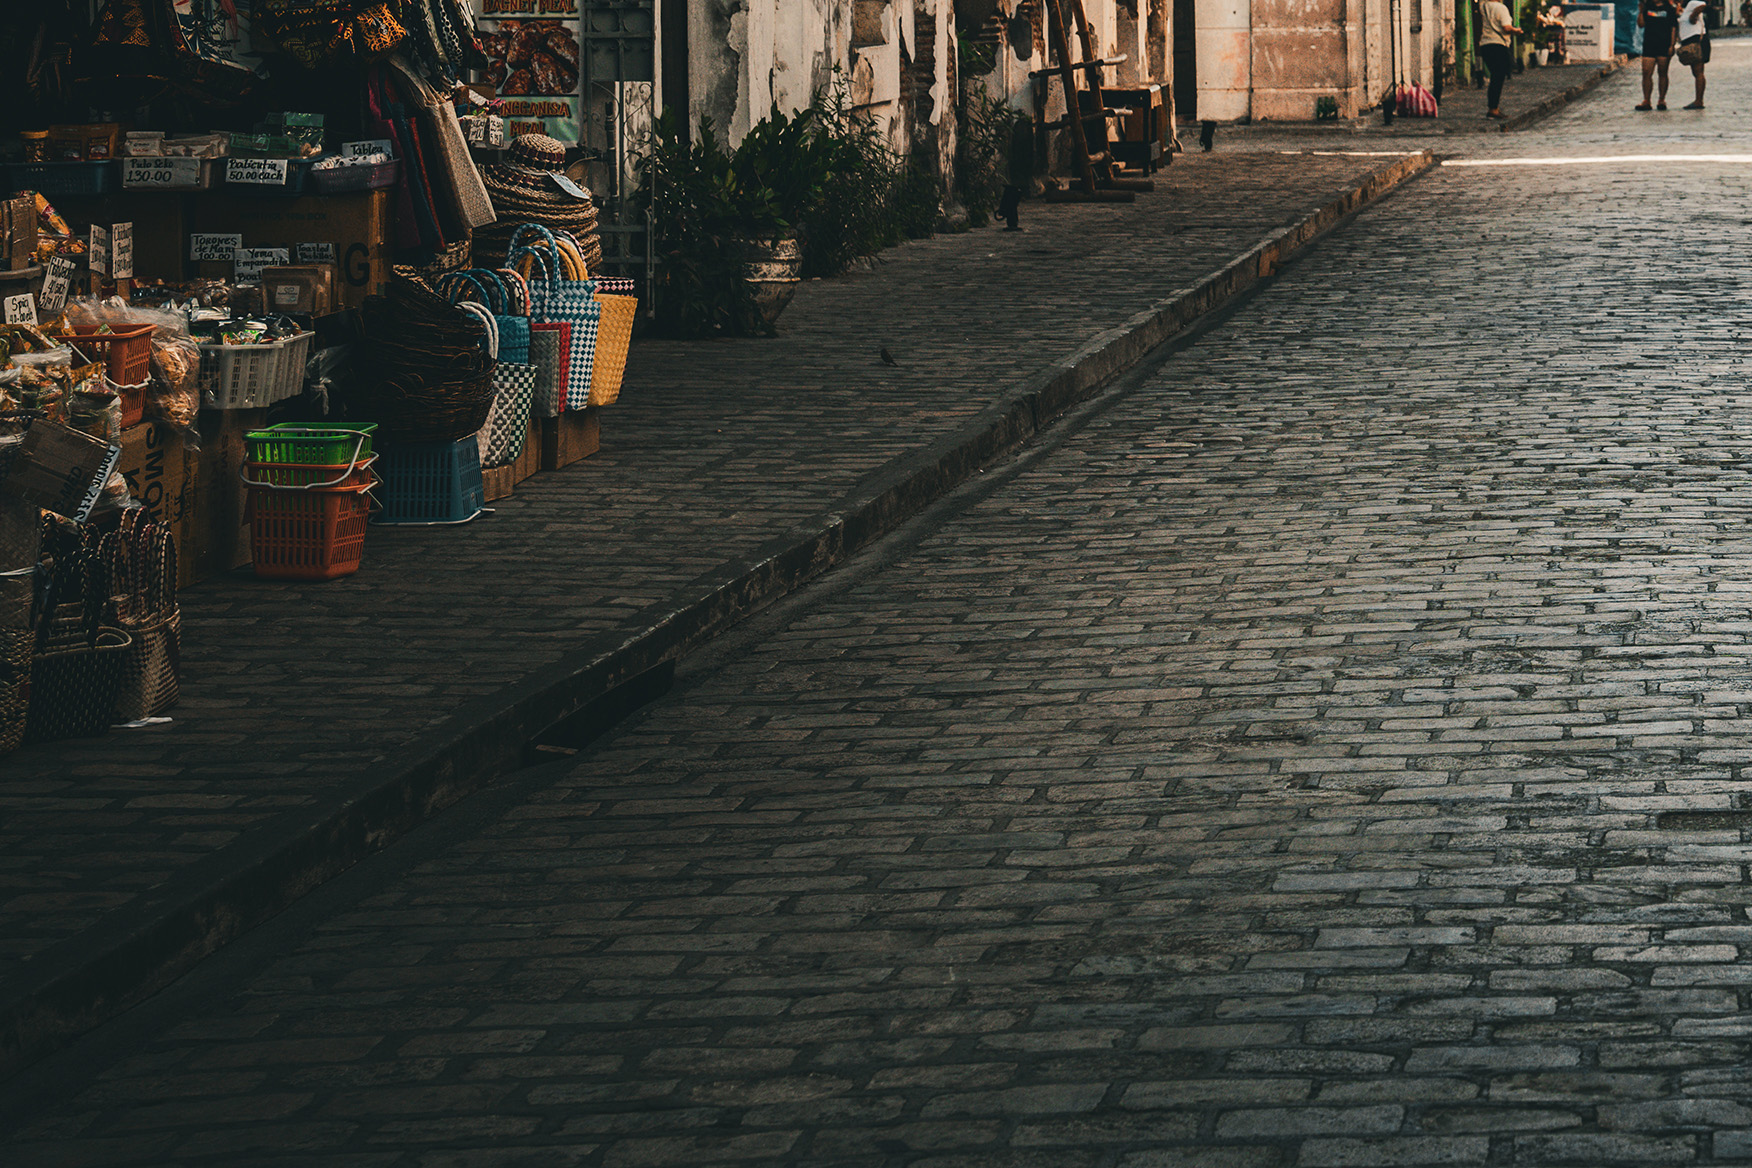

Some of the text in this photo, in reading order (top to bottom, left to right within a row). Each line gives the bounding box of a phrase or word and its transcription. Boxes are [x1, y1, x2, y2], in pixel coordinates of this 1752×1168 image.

[500, 100, 572, 118] NGGANISA
[509, 120, 548, 137] MEAL
[130, 158, 152, 169] Puto
[126, 170, 172, 182] 130.00
[229, 169, 284, 181] 50.00 each
[194, 245, 208, 253] de
